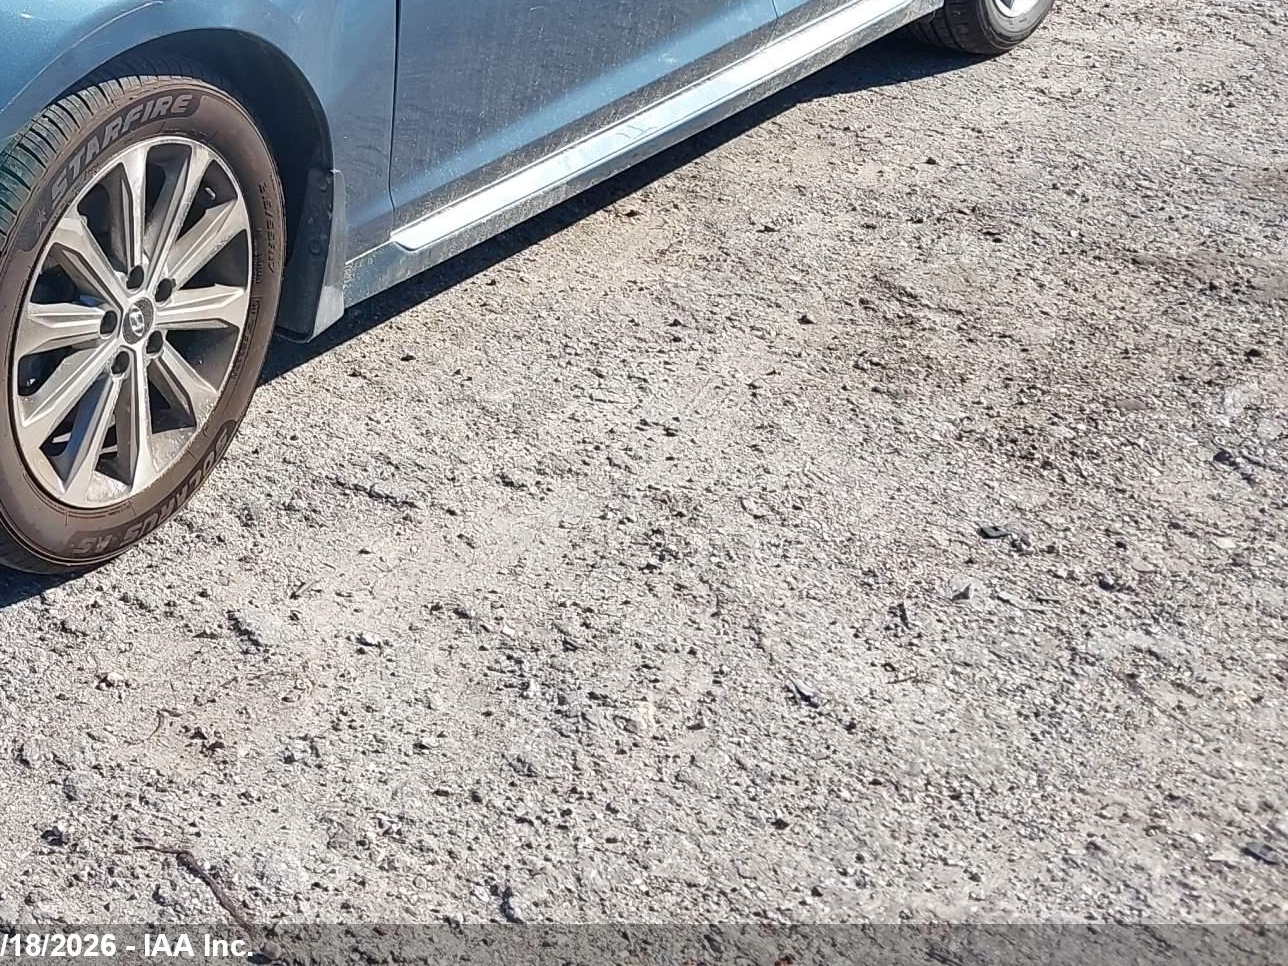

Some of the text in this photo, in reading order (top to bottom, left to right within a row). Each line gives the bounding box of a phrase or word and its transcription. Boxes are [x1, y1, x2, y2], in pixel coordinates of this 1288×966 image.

[51, 94, 194, 210] STARFIRE
[70, 425, 229, 554] SOLARUS AS
